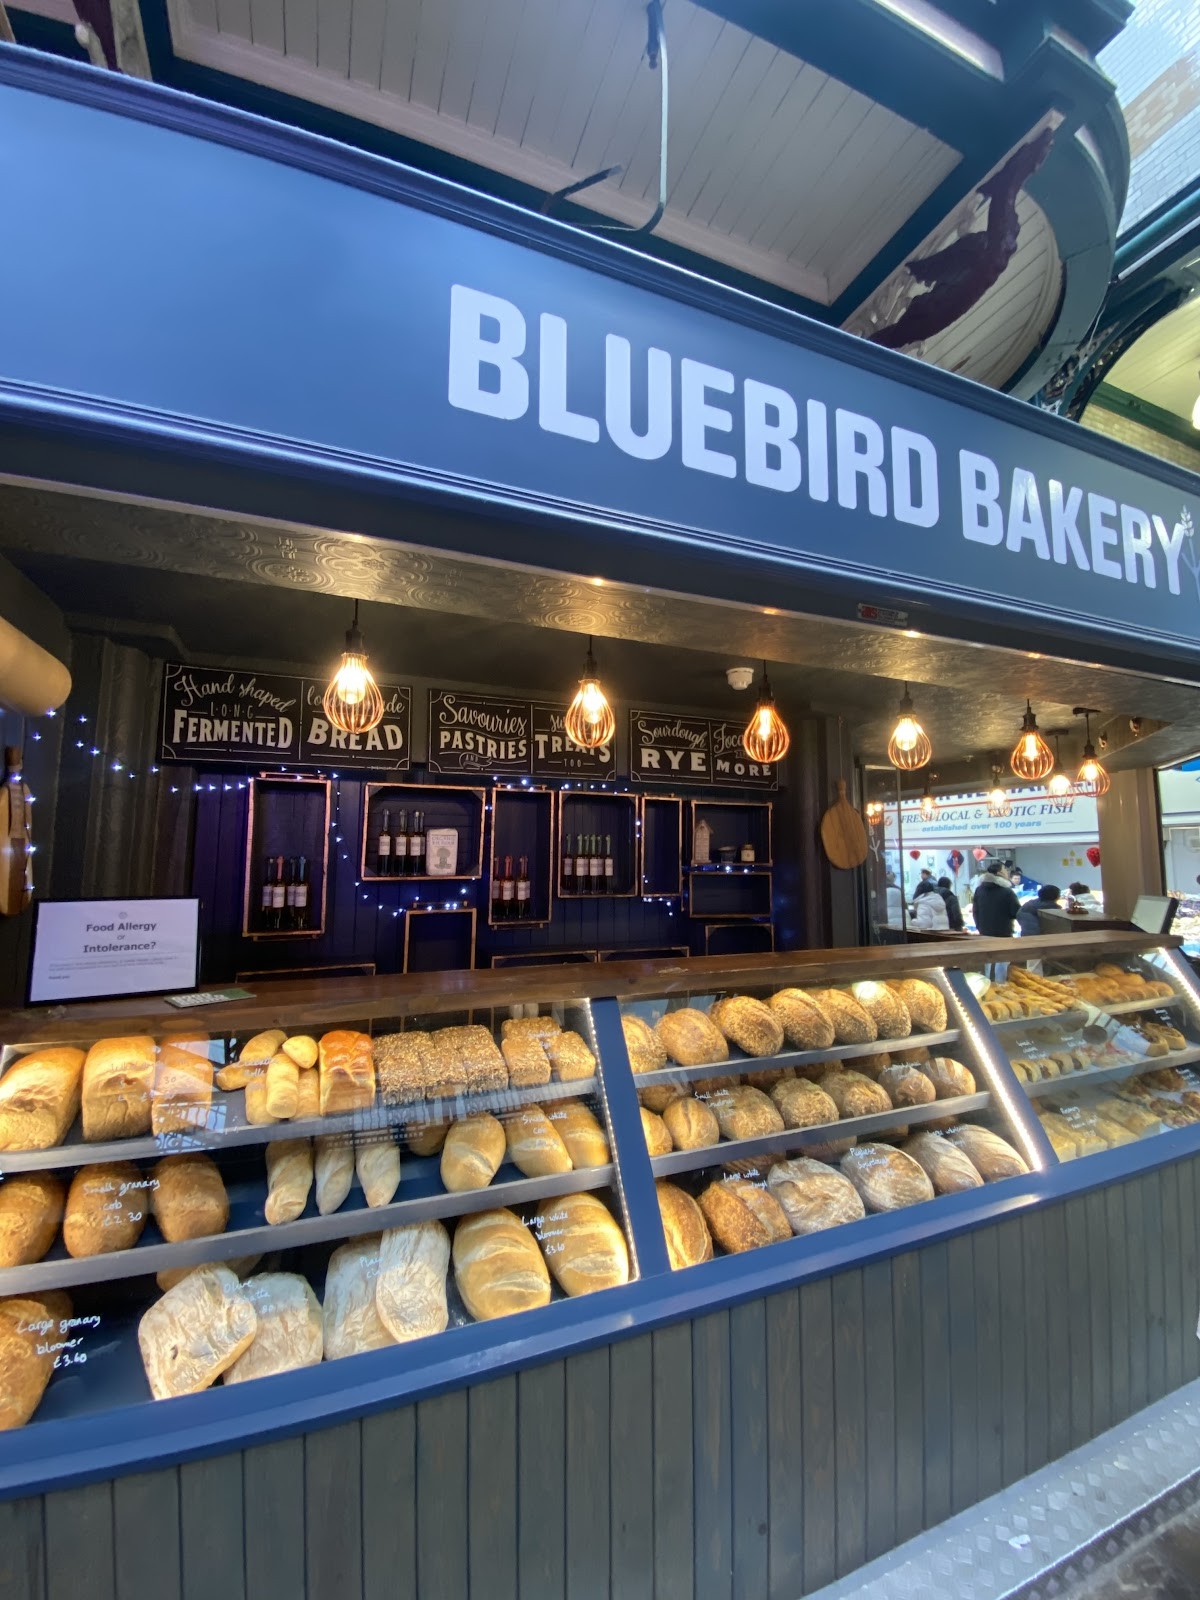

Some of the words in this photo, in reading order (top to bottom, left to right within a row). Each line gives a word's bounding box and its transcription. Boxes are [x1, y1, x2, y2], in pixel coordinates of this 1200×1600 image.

[449, 284, 939, 528] BLUEBIRD
[959, 449, 1186, 596] BAKERY
[174, 674, 235, 707] Hand
[239, 678, 297, 712] shaped
[172, 709, 293, 749] FERMENTED
[439, 694, 527, 737] Savouries
[307, 717, 403, 751] BREAD
[440, 730, 527, 760] PASTRIES
[637, 720, 708, 750] Sourdough
[640, 747, 707, 772] RYE
[716, 758, 772, 777] MORE
[936, 809, 970, 822] LOCAL
[974, 809, 983, 819] &
[1039, 802, 1074, 815] FISH
[921, 824, 968, 832] established
[994, 821, 1012, 829] 100
[1015, 820, 1042, 829] years
[86, 923, 115, 932] Food
[118, 922, 157, 932] Allergy
[83, 941, 157, 953] Intolerance?
[16, 1319, 54, 1336] Large
